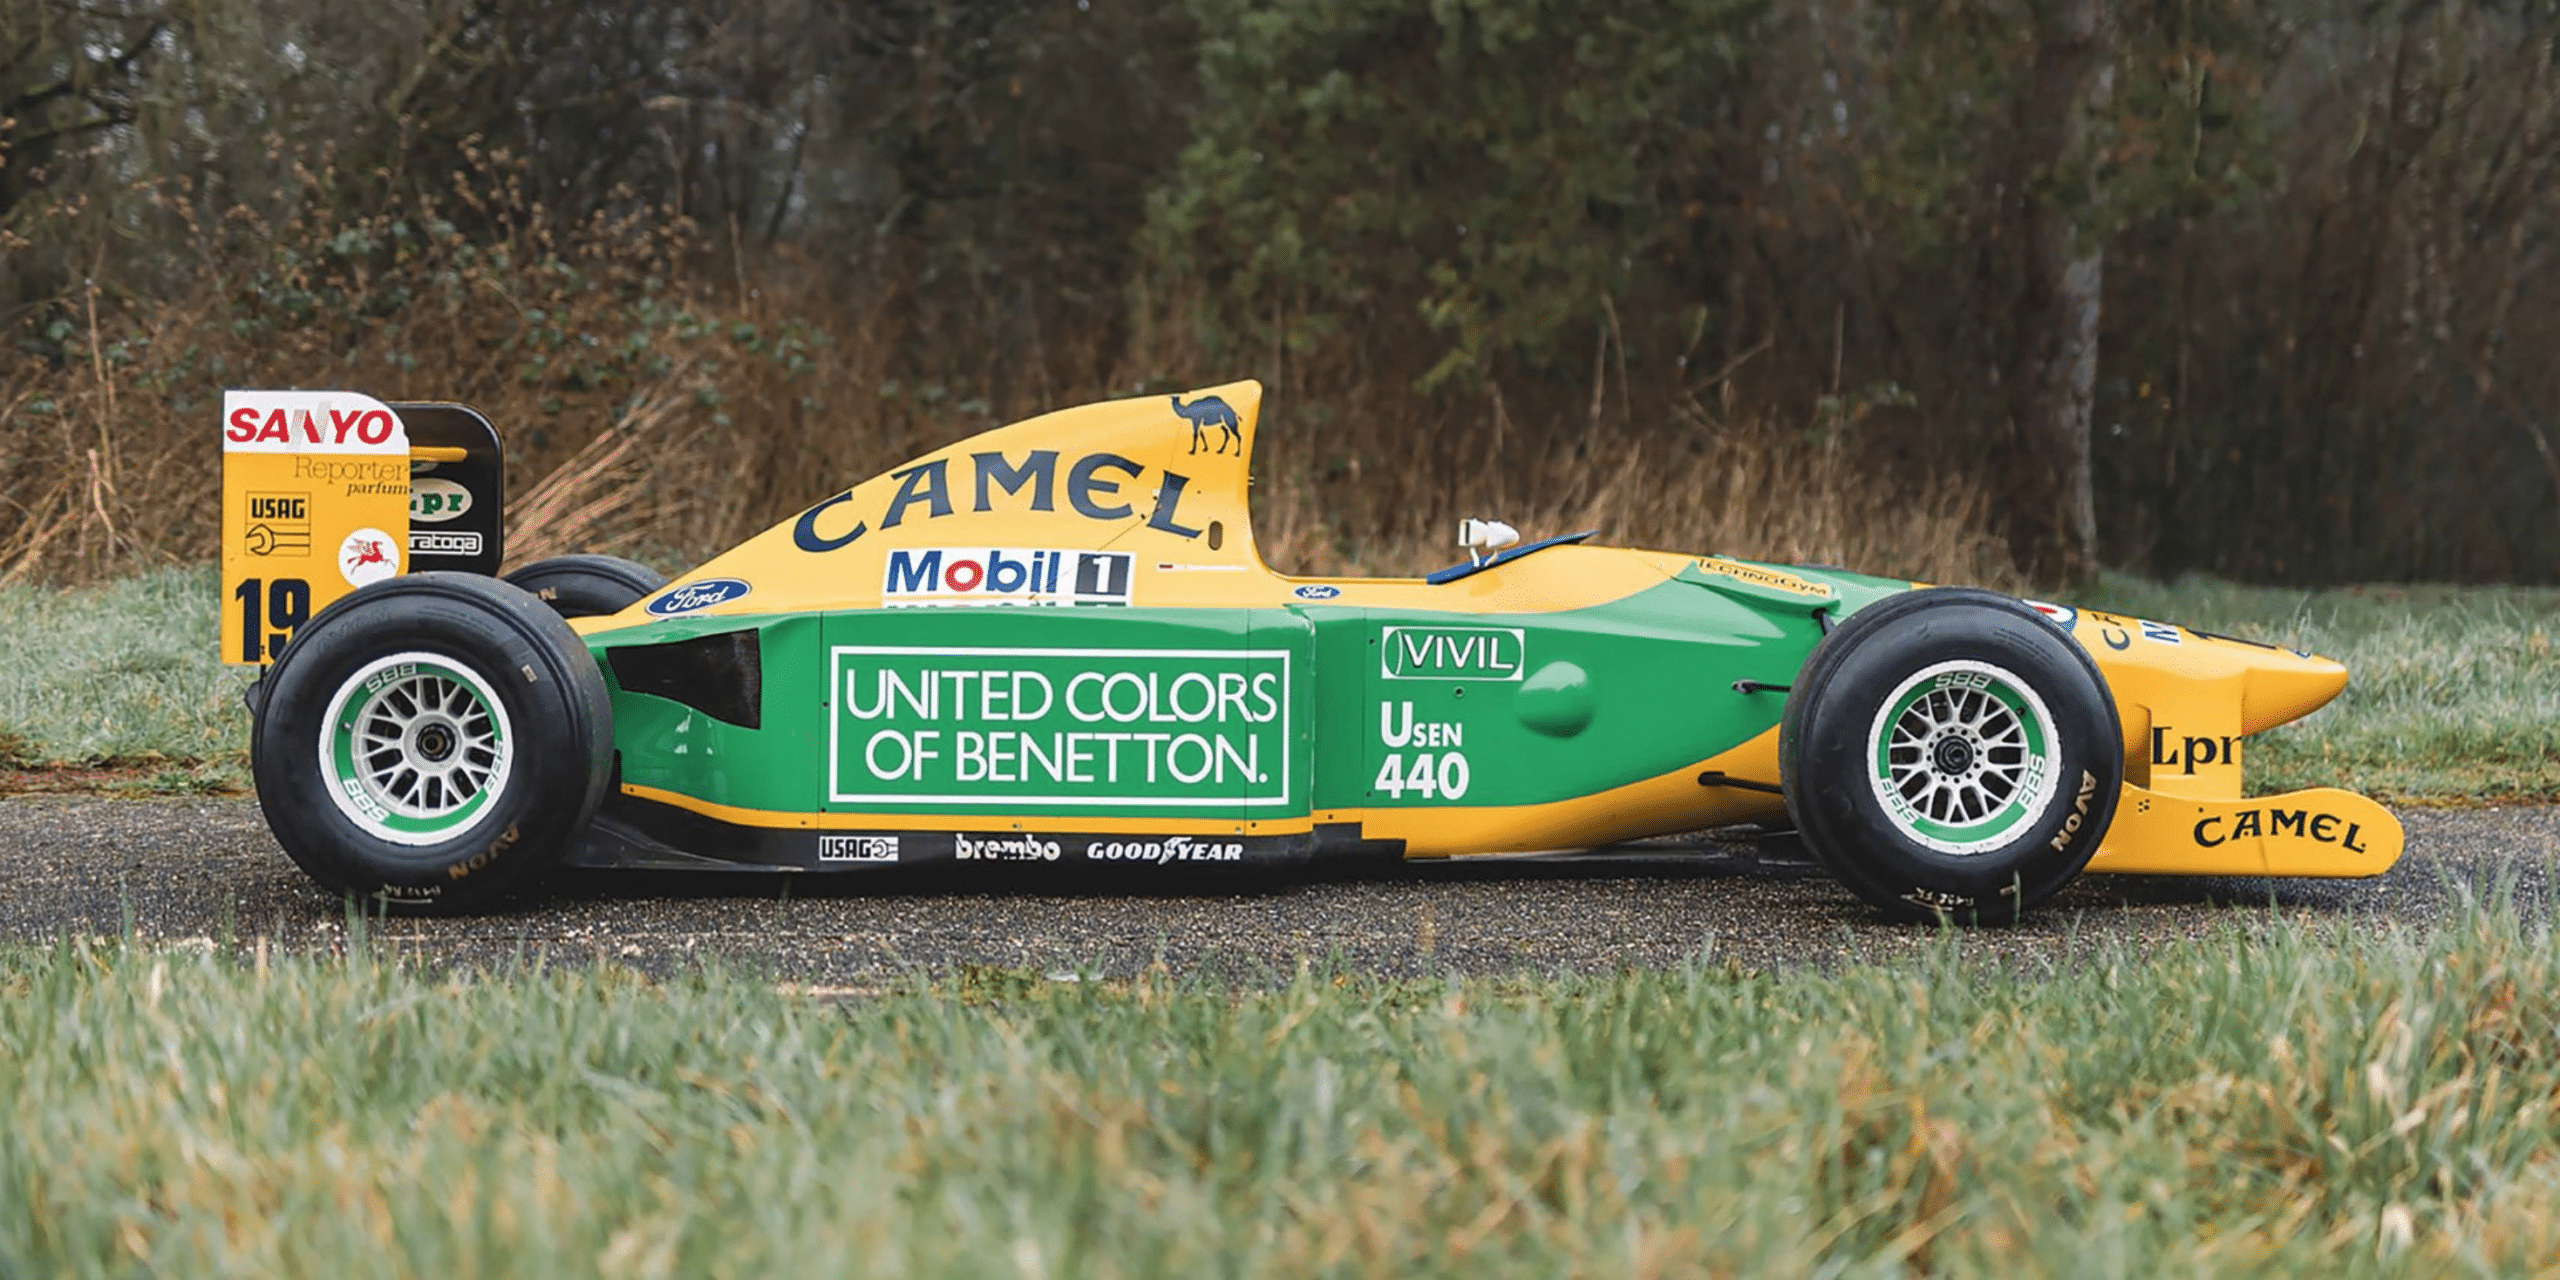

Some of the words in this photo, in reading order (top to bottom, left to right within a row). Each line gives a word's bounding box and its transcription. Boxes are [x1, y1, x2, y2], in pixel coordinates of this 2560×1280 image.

[226, 407, 394, 445] SANYO
[294, 456, 408, 485] Reporter
[251, 498, 305, 519] USAG
[792, 449, 1205, 553] CAMEL
[409, 533, 477, 553] ratoga
[886, 550, 1061, 593] Mobil
[664, 583, 730, 612] Ford
[235, 578, 310, 662] 19
[1403, 633, 1515, 670] VIVIL
[846, 669, 1053, 721] UNITED
[1065, 671, 1277, 723] COLORS
[865, 728, 941, 781] OF
[956, 731, 1269, 784] BENETTON.
[2152, 725, 2242, 776] Lpr
[1375, 751, 1470, 800] 440
[2050, 768, 2097, 852] AVON
[822, 838, 871, 859] USAG
[955, 833, 1061, 861] brembo
[1086, 836, 1244, 866] GOODYEAR
[2193, 808, 2367, 854] CAMEL
